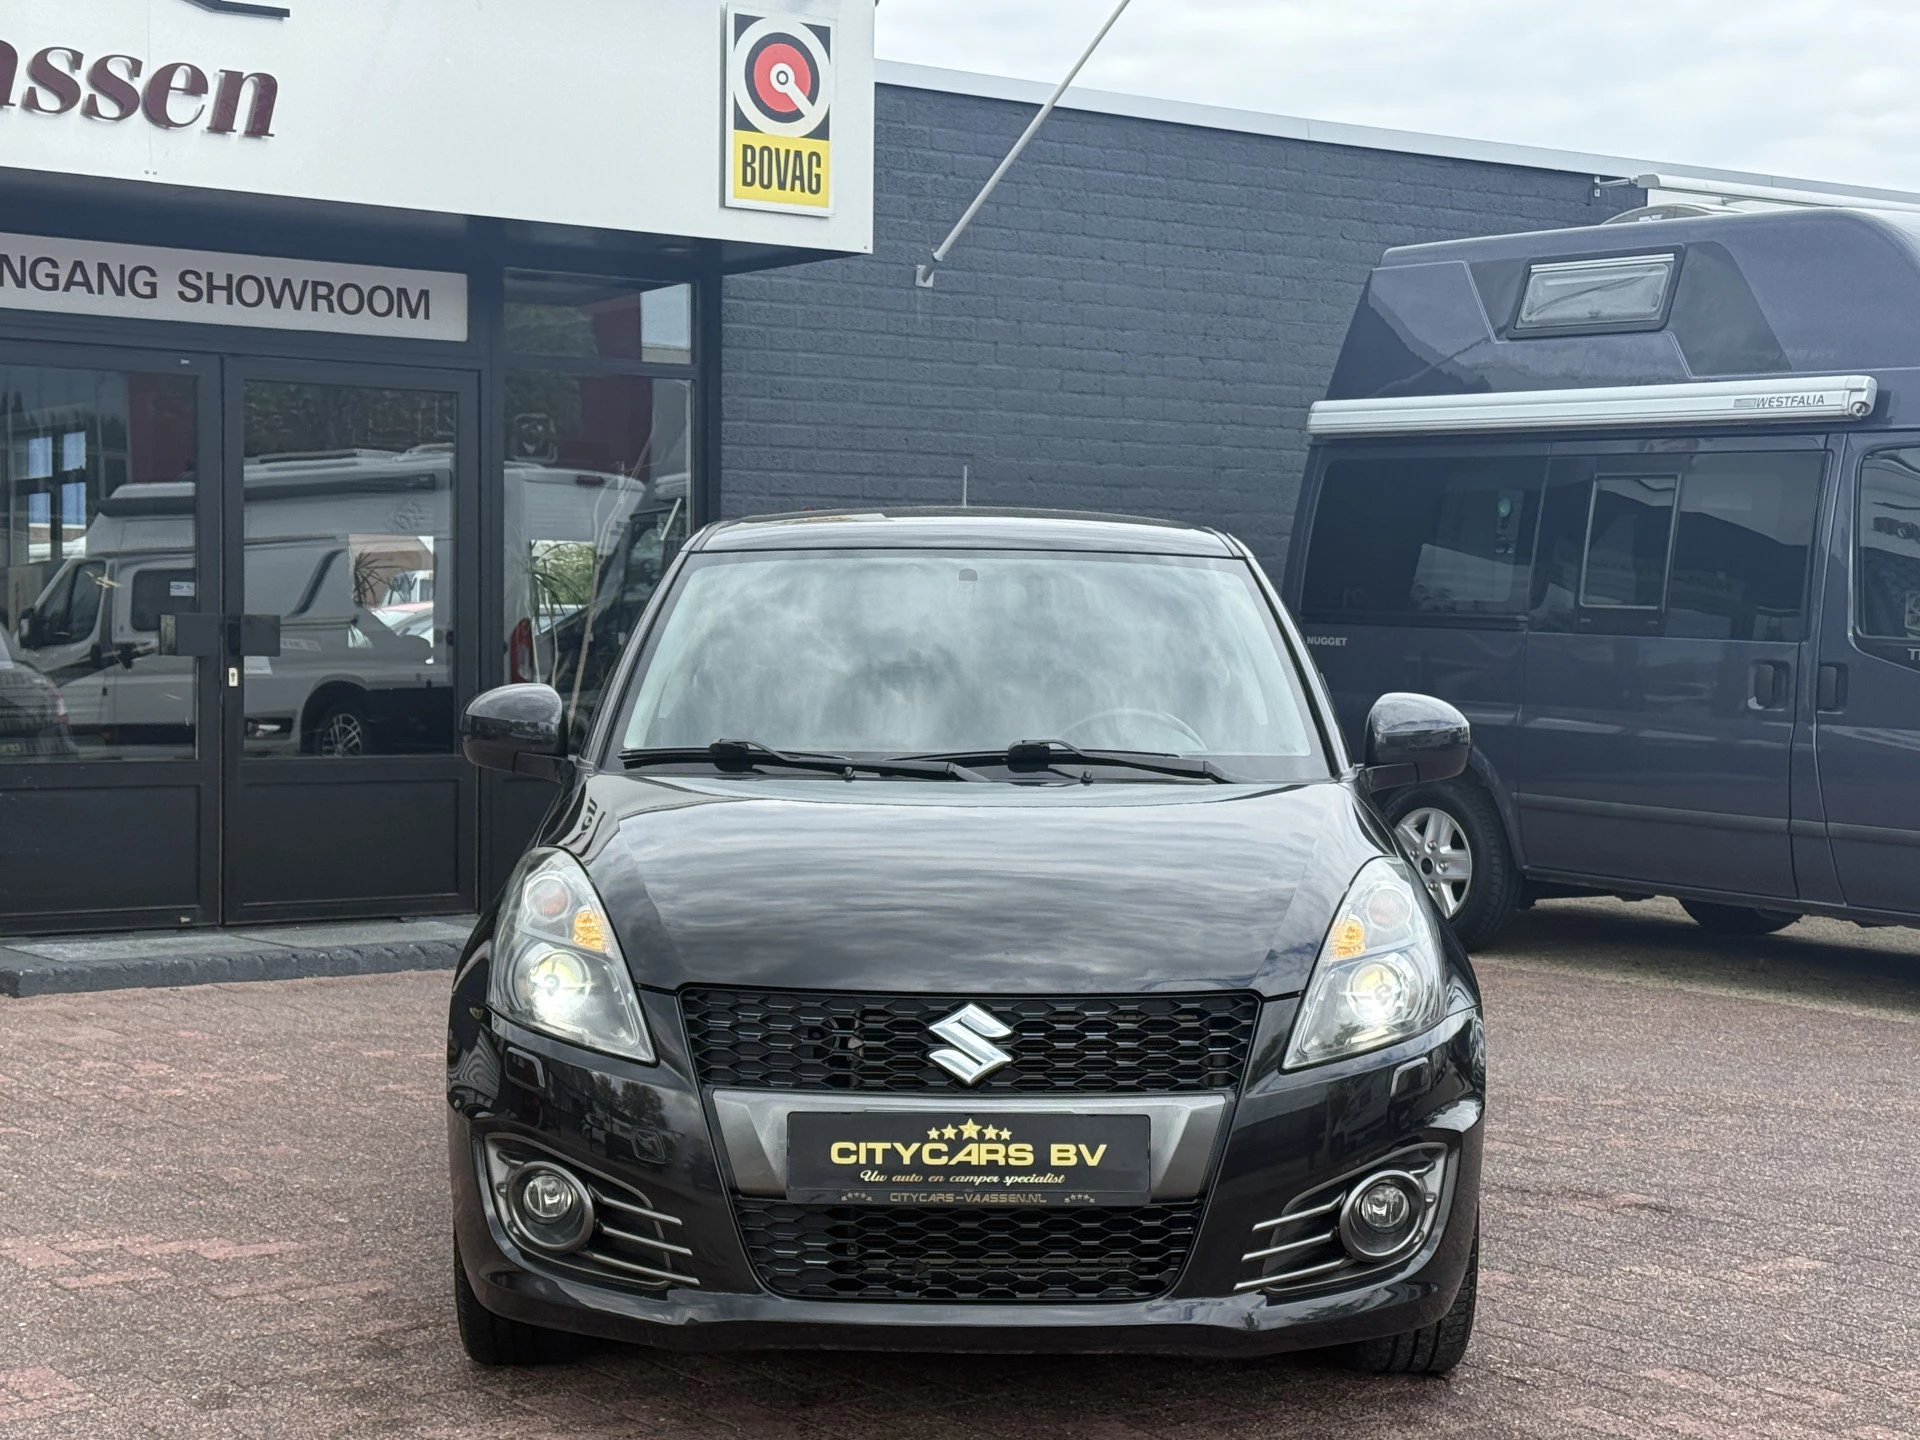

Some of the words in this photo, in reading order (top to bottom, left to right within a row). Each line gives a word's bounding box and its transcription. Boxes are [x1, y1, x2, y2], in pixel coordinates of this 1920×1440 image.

[742, 144, 821, 195] BOVAG
[0, 253, 158, 299] NGANG
[177, 269, 430, 320] SHOWROOM
[1756, 394, 1825, 408] WESTFALIA
[1306, 636, 1347, 646] NUGGET
[830, 1141, 1034, 1166] CITYCARS
[1050, 1143, 1107, 1167] BV
[860, 1169, 888, 1182] Uw
[892, 1173, 923, 1183] auto
[928, 1174, 945, 1182] en
[949, 1174, 1000, 1186] camper
[1003, 1173, 1065, 1186] specialist
[890, 1192, 1047, 1203] CITYCARS-VAASSEN.NL
